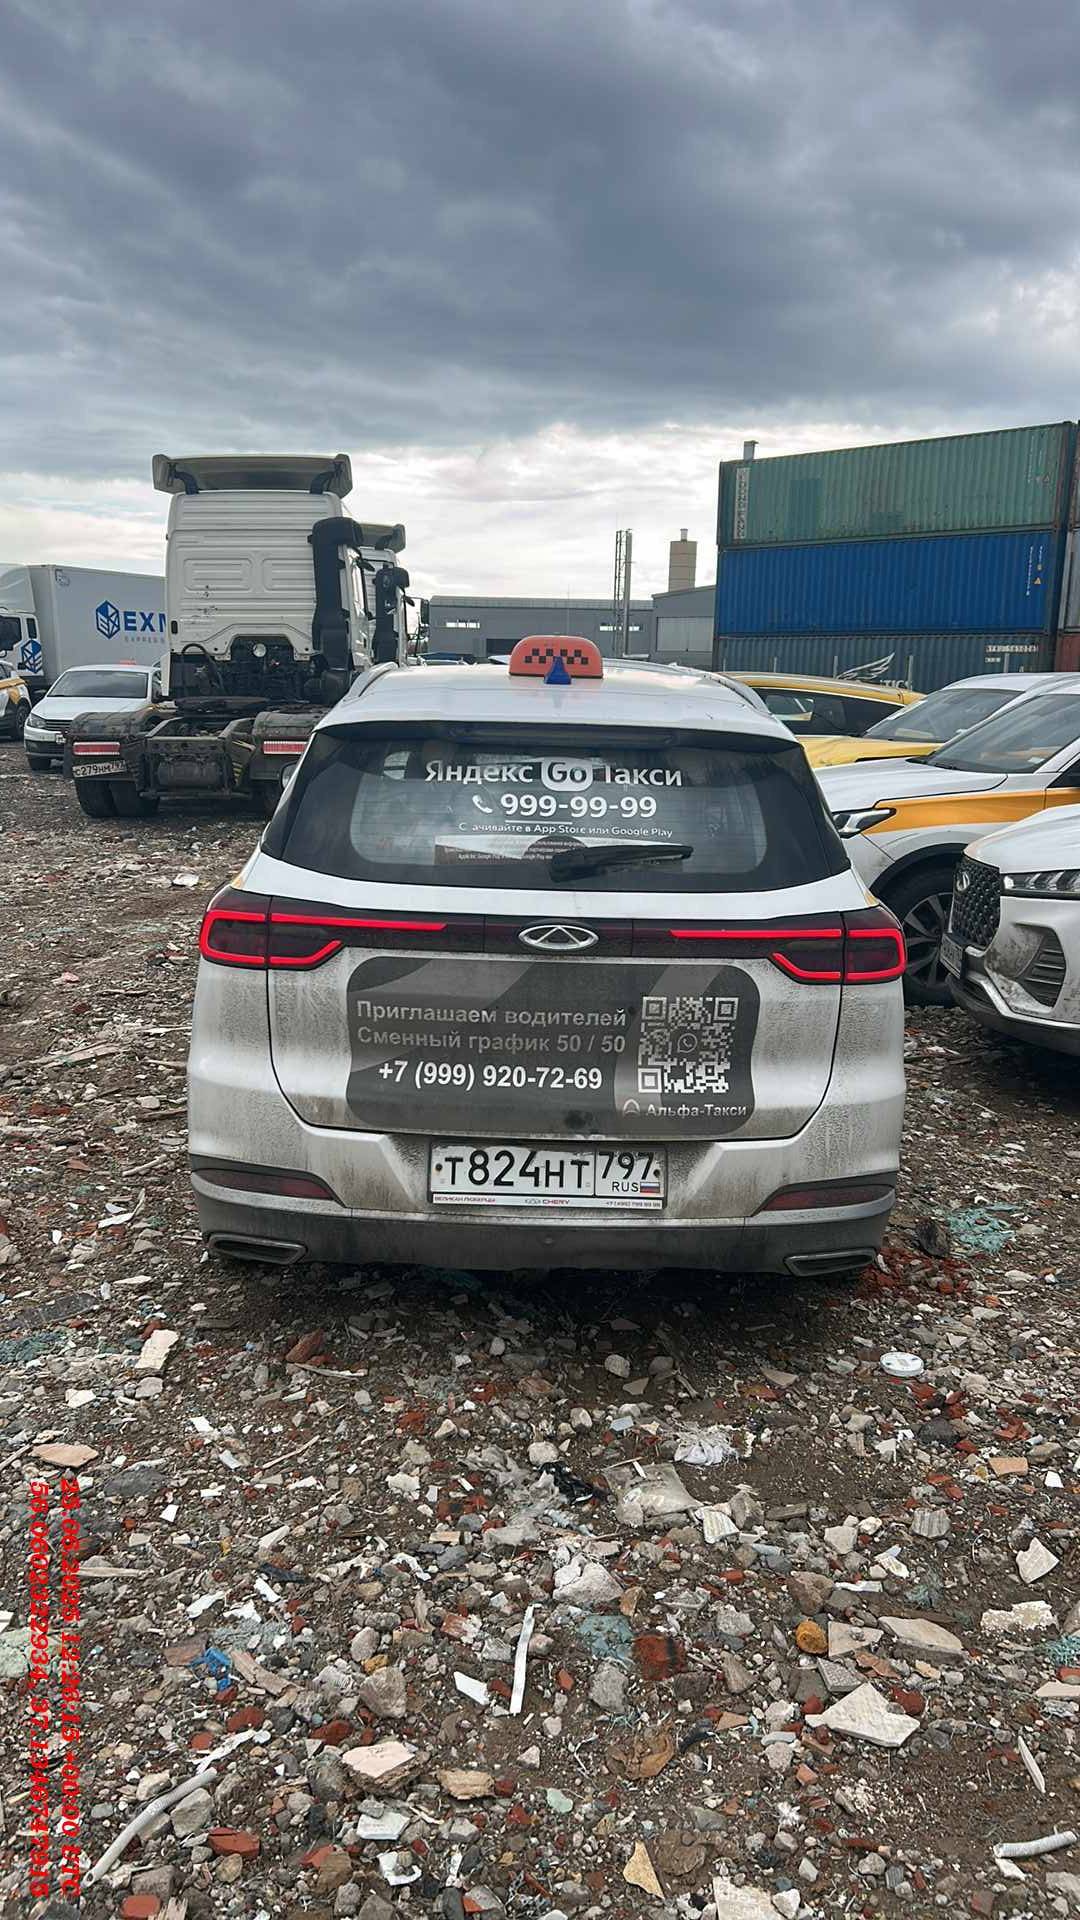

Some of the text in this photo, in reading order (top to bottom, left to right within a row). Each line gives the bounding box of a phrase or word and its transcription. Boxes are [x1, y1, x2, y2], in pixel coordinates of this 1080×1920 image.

[424, 760, 534, 785] Яндекс
[551, 761, 585, 782] Go
[500, 793, 657, 818] 999-99-99
[459, 822, 523, 832] Сачивайте
[534, 825, 556, 834] App
[558, 825, 586, 834] Store
[611, 826, 649, 836] Google
[651, 828, 673, 838] Play
[357, 1000, 626, 1027] Приглашаем водителей
[357, 1026, 626, 1054] Сменный график 50 / 50
[378, 1060, 603, 1090] +7 (999) 920-72-69
[645, 1103, 748, 1118] Альфа-Такси
[611, 1181, 640, 1193] RUS
